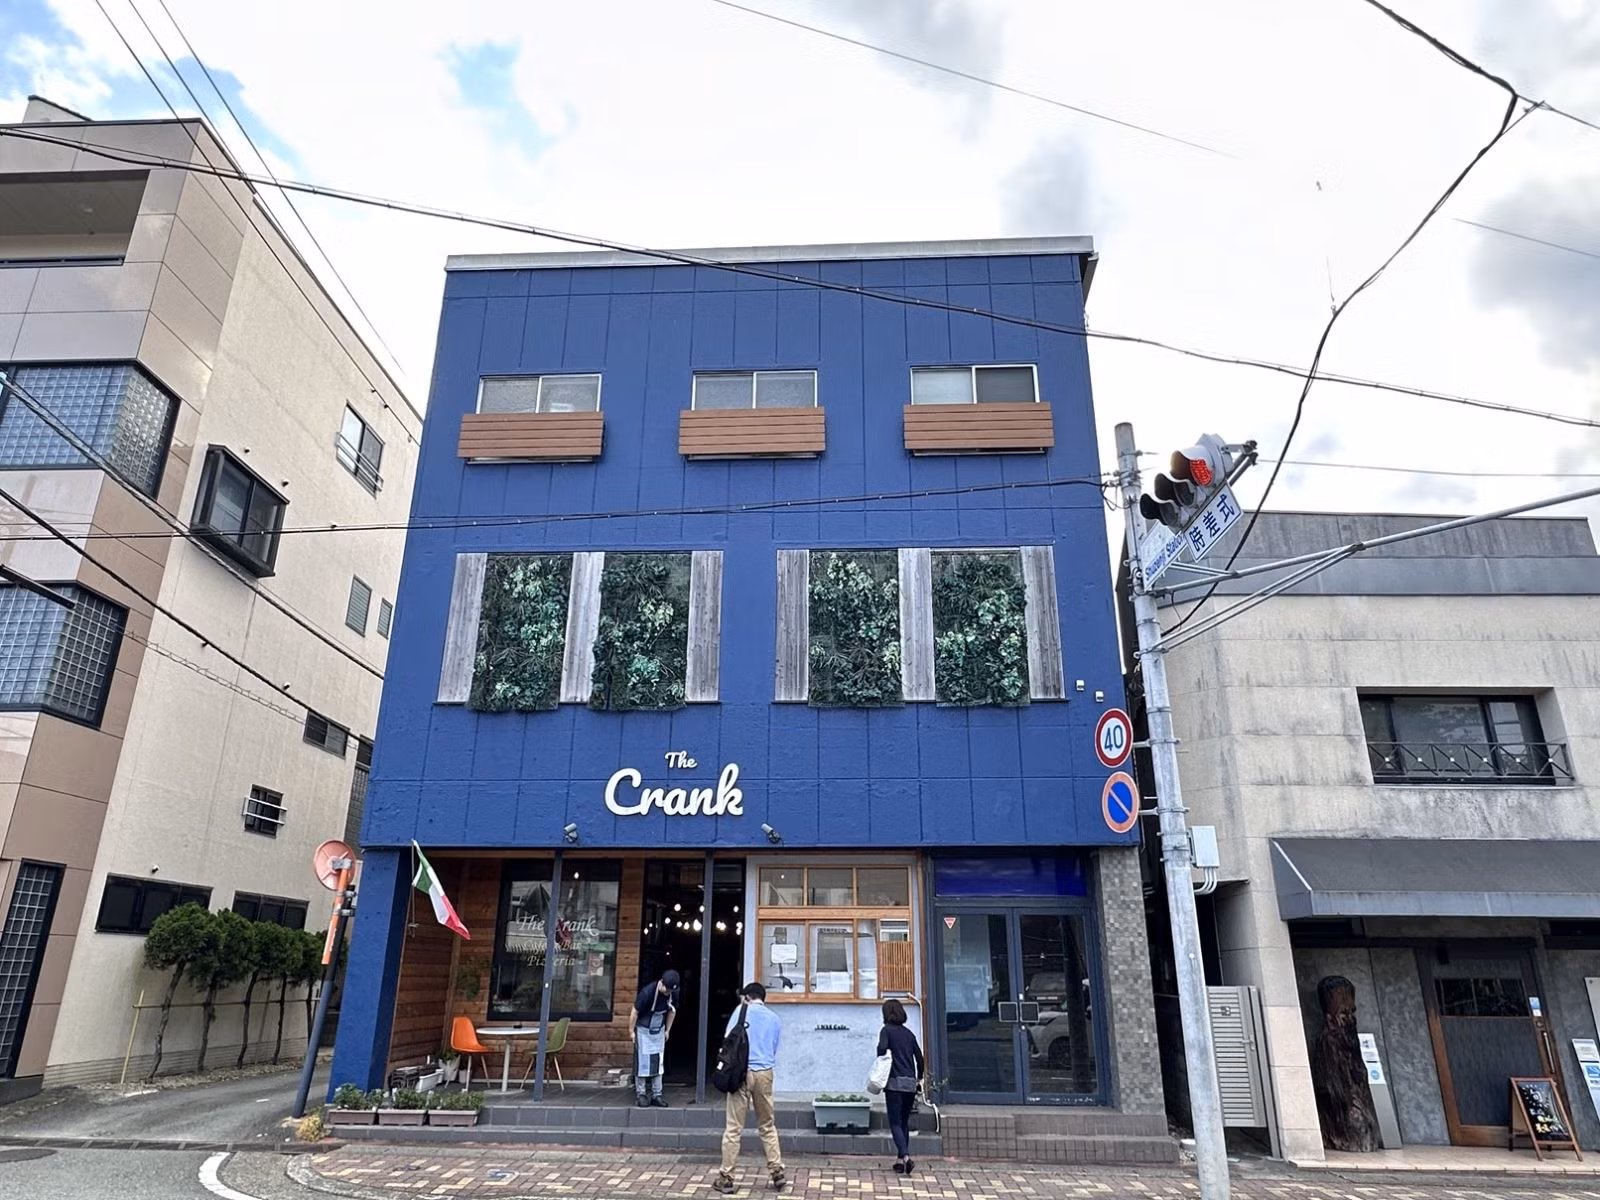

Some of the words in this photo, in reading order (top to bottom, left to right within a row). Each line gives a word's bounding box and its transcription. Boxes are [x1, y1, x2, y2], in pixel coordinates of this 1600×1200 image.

[1189, 494, 1235, 552] 時差式
[1104, 725, 1124, 751] 40
[664, 750, 698, 769] The
[604, 763, 744, 816] Crank
[515, 908, 546, 931] The
[527, 955, 576, 967] Pizeria
